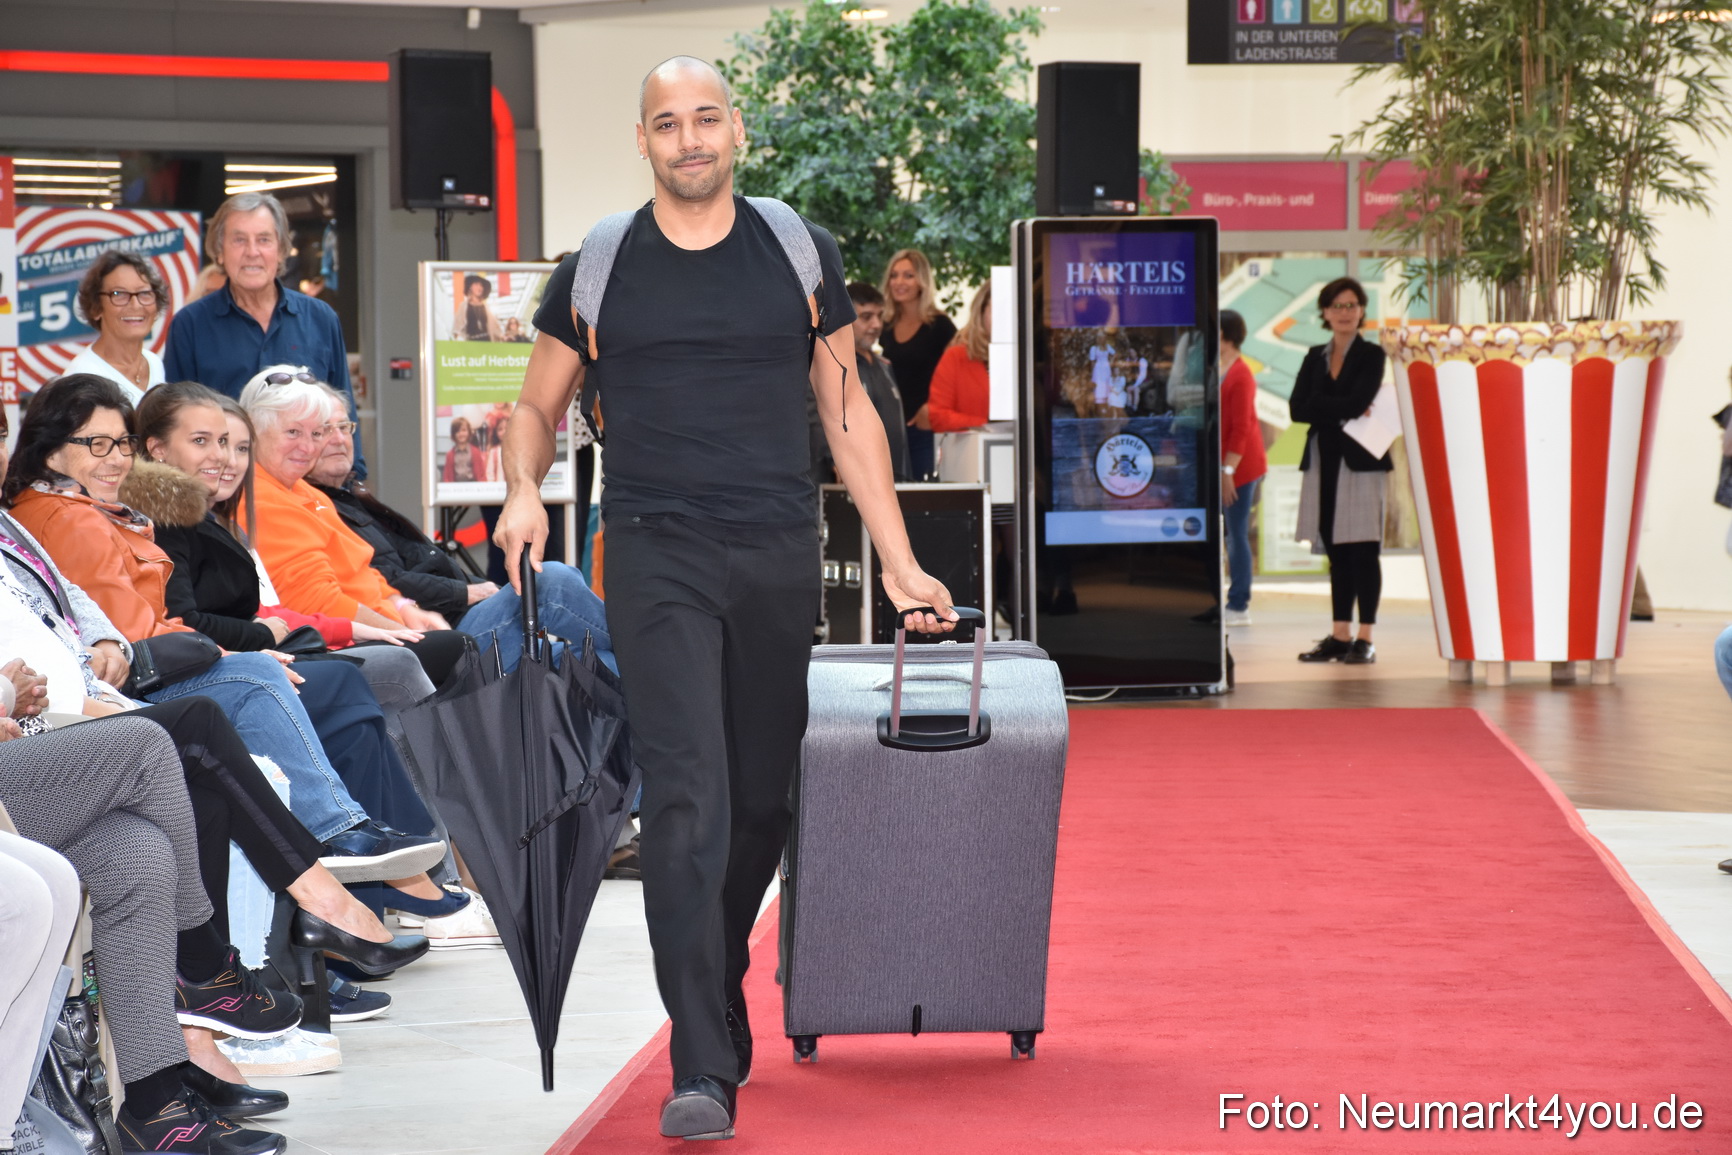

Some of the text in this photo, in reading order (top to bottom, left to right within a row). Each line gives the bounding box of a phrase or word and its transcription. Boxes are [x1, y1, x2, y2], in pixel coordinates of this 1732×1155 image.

[1236, 30, 1338, 43] IN DER UNTEREN
[1236, 47, 1338, 61] LADENSTRASSE
[1289, 192, 1315, 207] und
[1066, 261, 1187, 285] HÄRTEIS
[441, 355, 466, 368] Lust
[468, 354, 486, 368] auf
